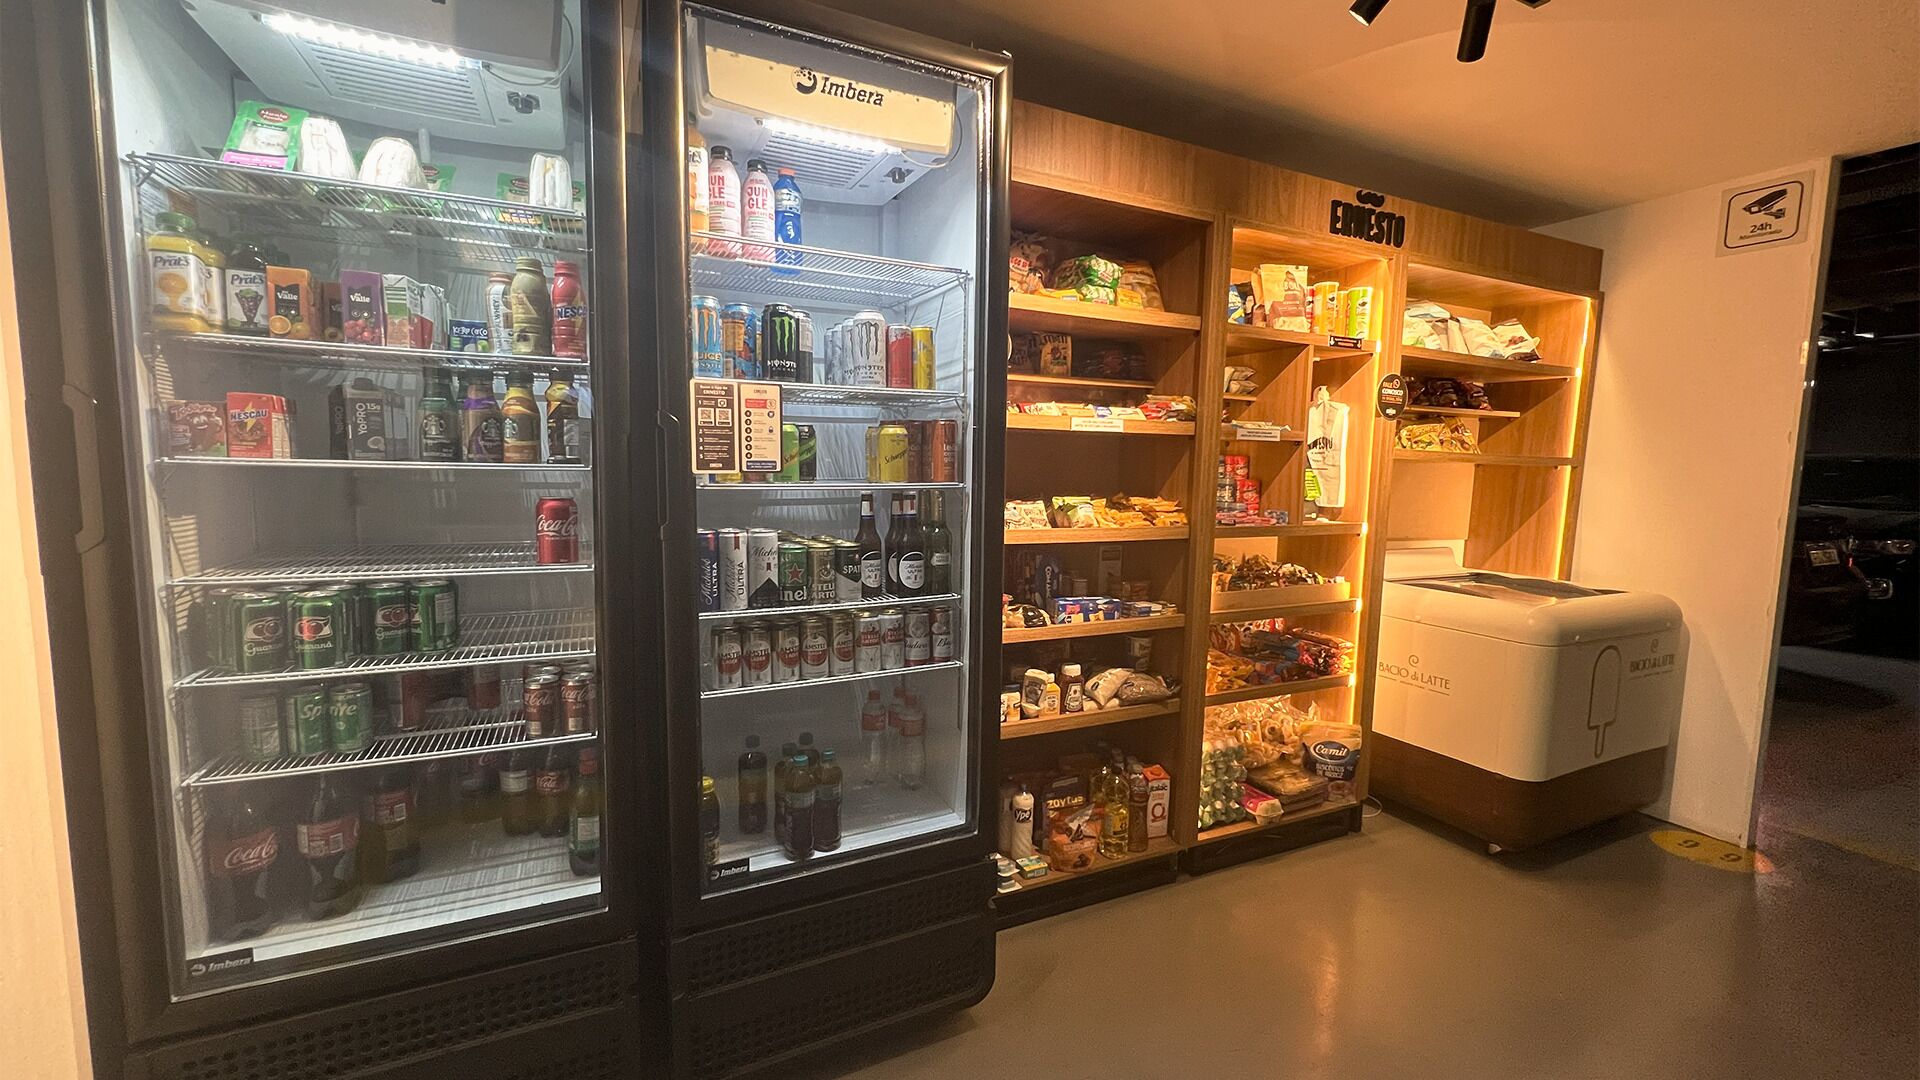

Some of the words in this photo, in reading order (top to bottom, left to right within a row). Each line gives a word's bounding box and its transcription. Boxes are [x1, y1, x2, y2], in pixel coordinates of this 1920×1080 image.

[820, 76, 885, 107] Imbera
[747, 186, 768, 198] JUN
[748, 198, 767, 209] GLE
[1329, 199, 1406, 249] ERNESTO
[1750, 222, 1772, 233] 24h
[277, 291, 298, 301] Valle
[350, 294, 371, 303] Valle
[230, 409, 268, 421] NESCAU
[355, 402, 368, 435] YoPRO
[736, 561, 745, 596] ULTRA
[1378, 661, 1409, 679] BACIO
[1411, 671, 1421, 681] di
[1421, 672, 1451, 690] LATTE
[1315, 744, 1347, 757] Camil
[720, 865, 748, 878] Imbera
[208, 957, 252, 974] Imbera
